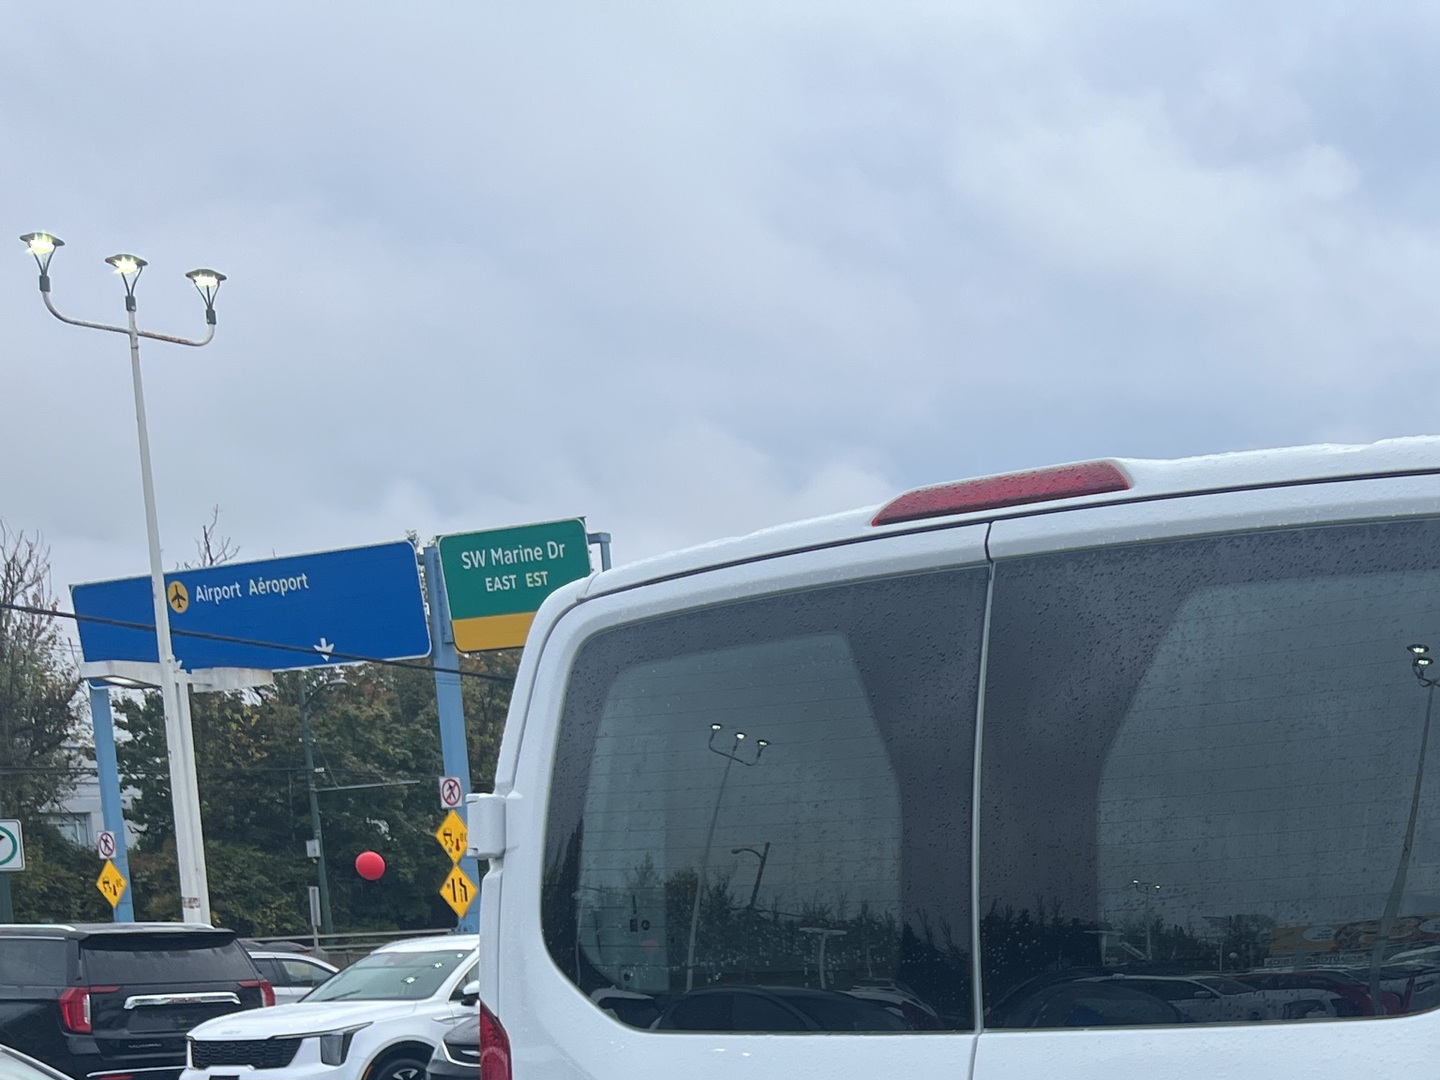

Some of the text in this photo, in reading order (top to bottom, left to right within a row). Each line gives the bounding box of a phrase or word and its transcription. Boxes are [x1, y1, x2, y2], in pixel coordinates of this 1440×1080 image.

[461, 541, 566, 570] SW Marine Dr
[196, 573, 309, 605] Airport Aéroport
[485, 571, 548, 592] EAST EST
